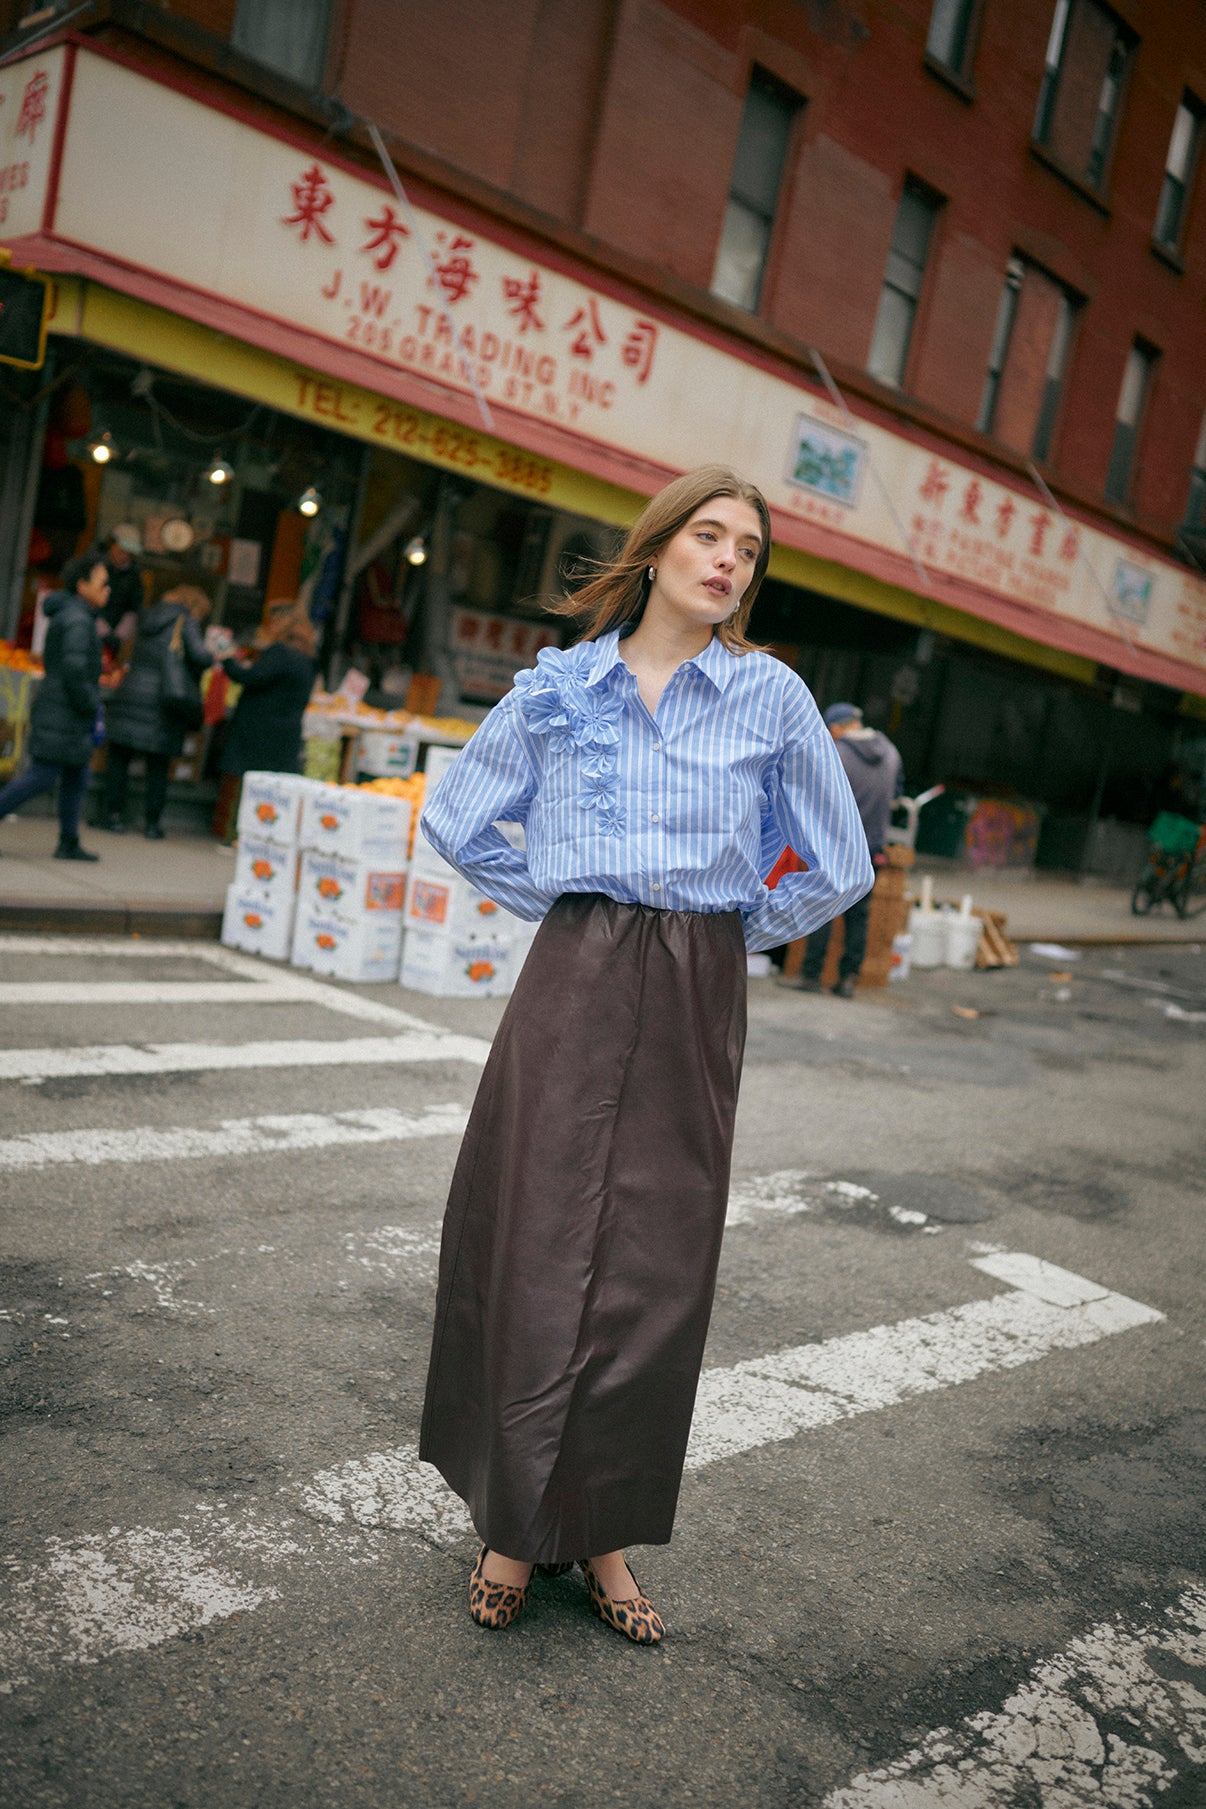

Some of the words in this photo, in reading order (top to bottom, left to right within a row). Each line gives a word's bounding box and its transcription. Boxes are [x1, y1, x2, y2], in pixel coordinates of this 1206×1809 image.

[283, 163, 660, 386] 東方海味公司
[399, 334, 494, 389] GRAND
[415, 303, 557, 387] TRADING
[567, 368, 616, 410] INC
